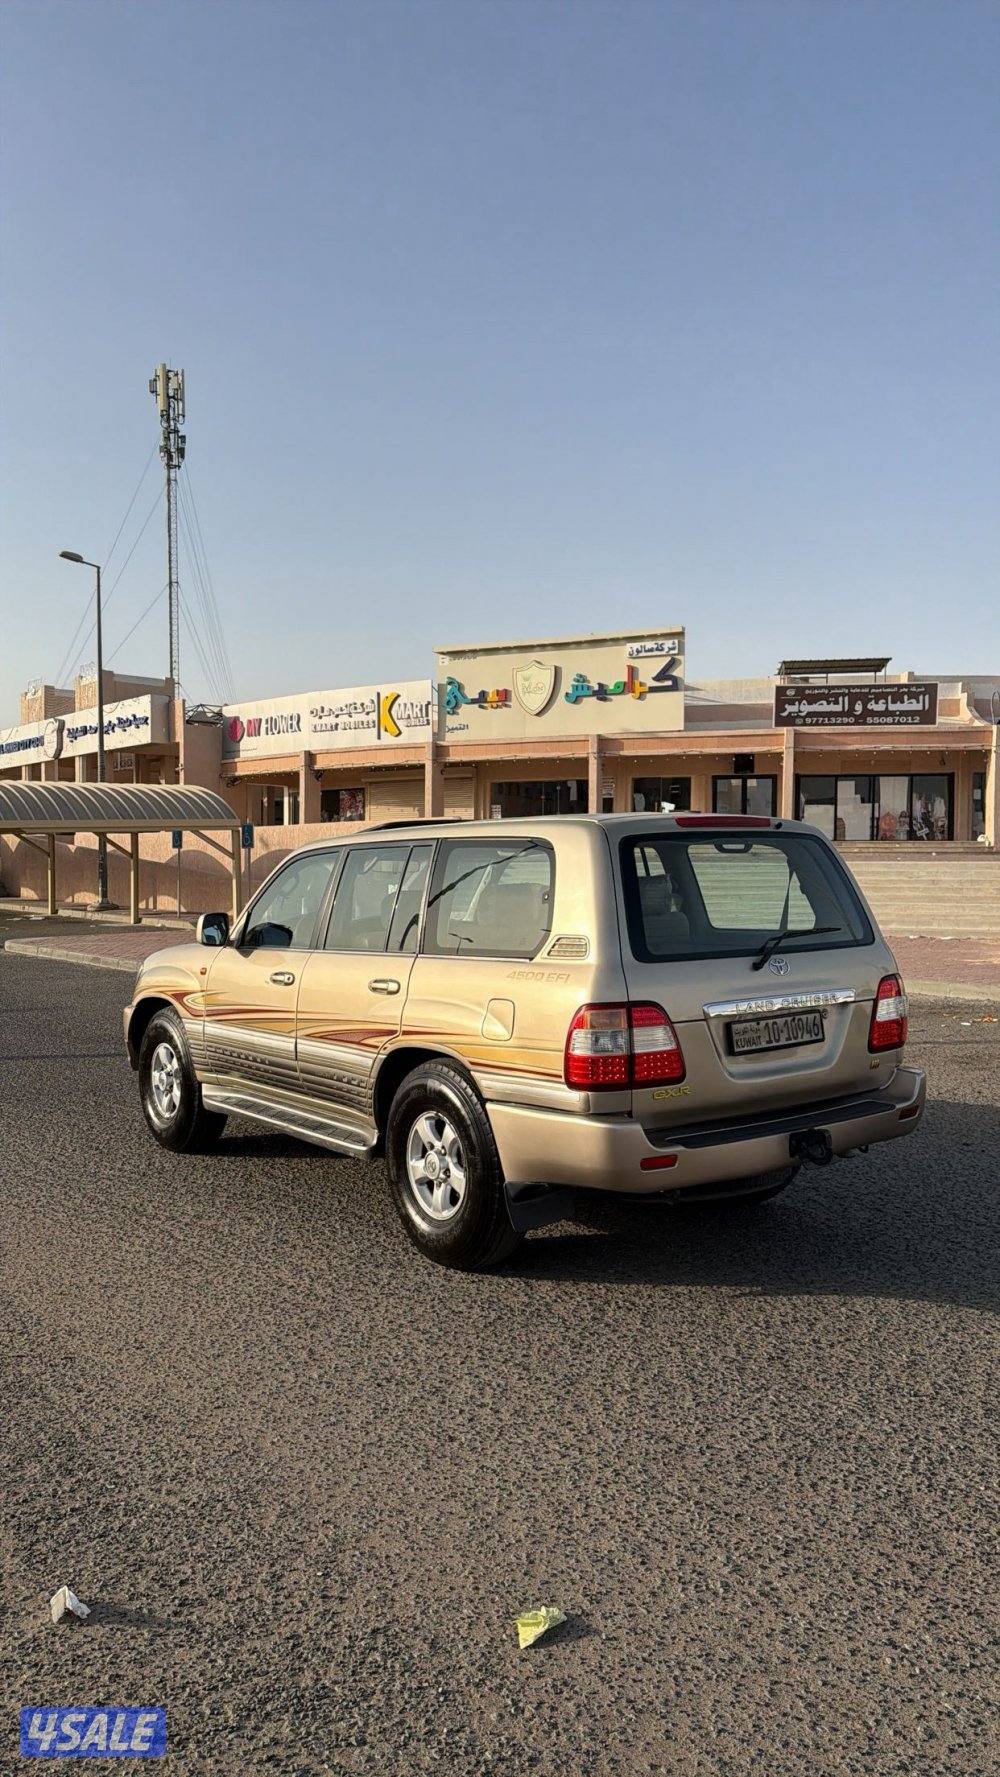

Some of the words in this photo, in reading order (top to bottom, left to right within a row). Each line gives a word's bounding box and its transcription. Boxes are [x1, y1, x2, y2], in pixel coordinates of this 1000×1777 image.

[628, 643, 655, 656] صالون
[655, 640, 677, 653] شركة
[780, 695, 849, 716] التصوير
[853, 700, 863, 715] و
[867, 694, 930, 715] الطباعة
[246, 717, 262, 738] MY
[264, 713, 301, 736] FLOWER
[506, 970, 545, 981] 4500
[735, 1000, 776, 1014] LAND
[781, 992, 840, 1009] CRUISER
[735, 1036, 761, 1049] KUWAIT
